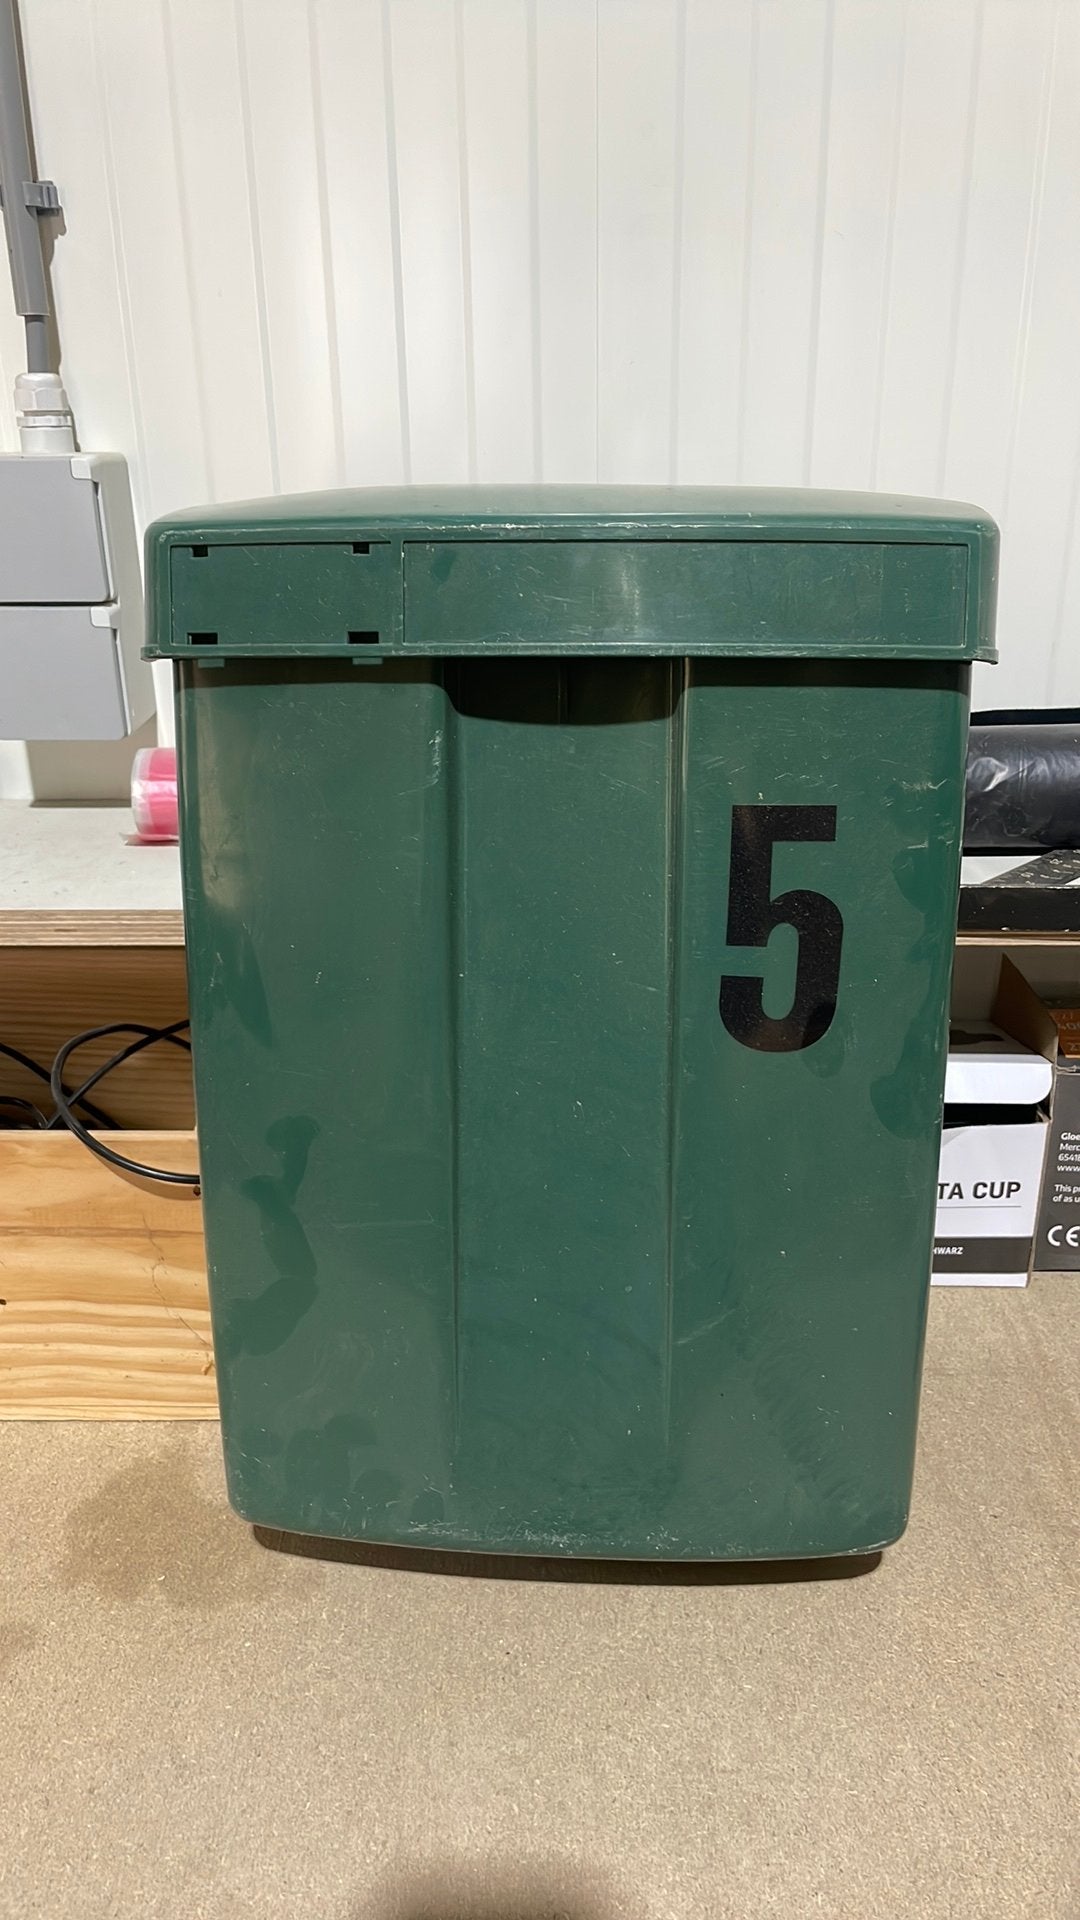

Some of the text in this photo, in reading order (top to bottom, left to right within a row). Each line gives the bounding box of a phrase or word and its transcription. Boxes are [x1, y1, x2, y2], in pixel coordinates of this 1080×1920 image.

[719, 805, 844, 1053] 5
[972, 1181, 1021, 1199] CUP
[1054, 1183, 1072, 1193] This
[1052, 1193, 1063, 1202] of
